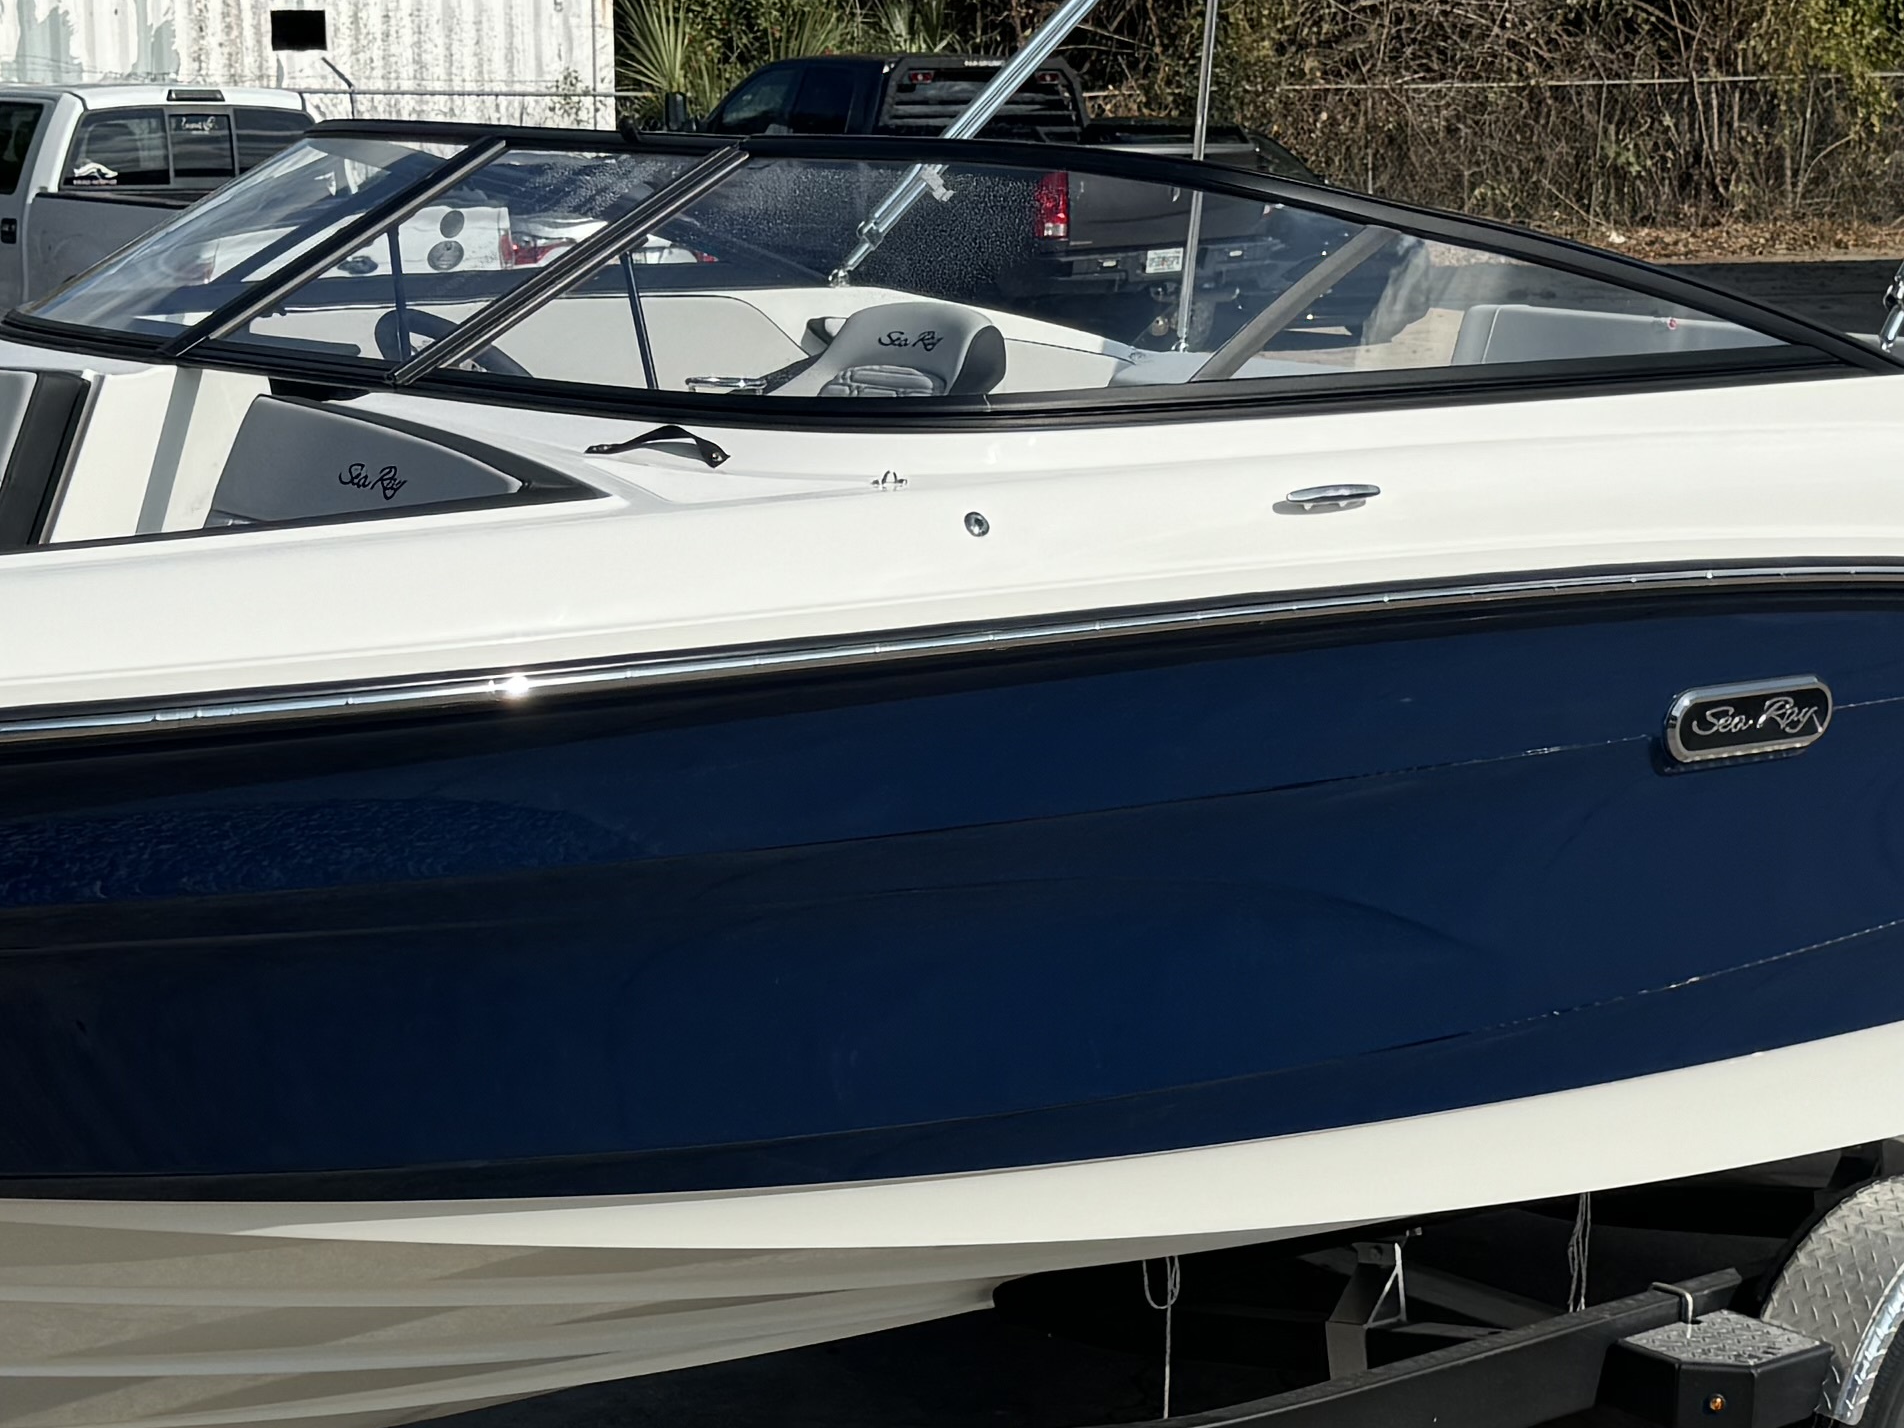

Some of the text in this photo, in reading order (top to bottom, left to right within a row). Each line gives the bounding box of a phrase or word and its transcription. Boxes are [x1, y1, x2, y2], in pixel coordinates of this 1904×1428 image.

[878, 330, 944, 352] Sea Ray
[338, 463, 408, 501] Sea Ray
[1691, 696, 1819, 736] Sea Ray
